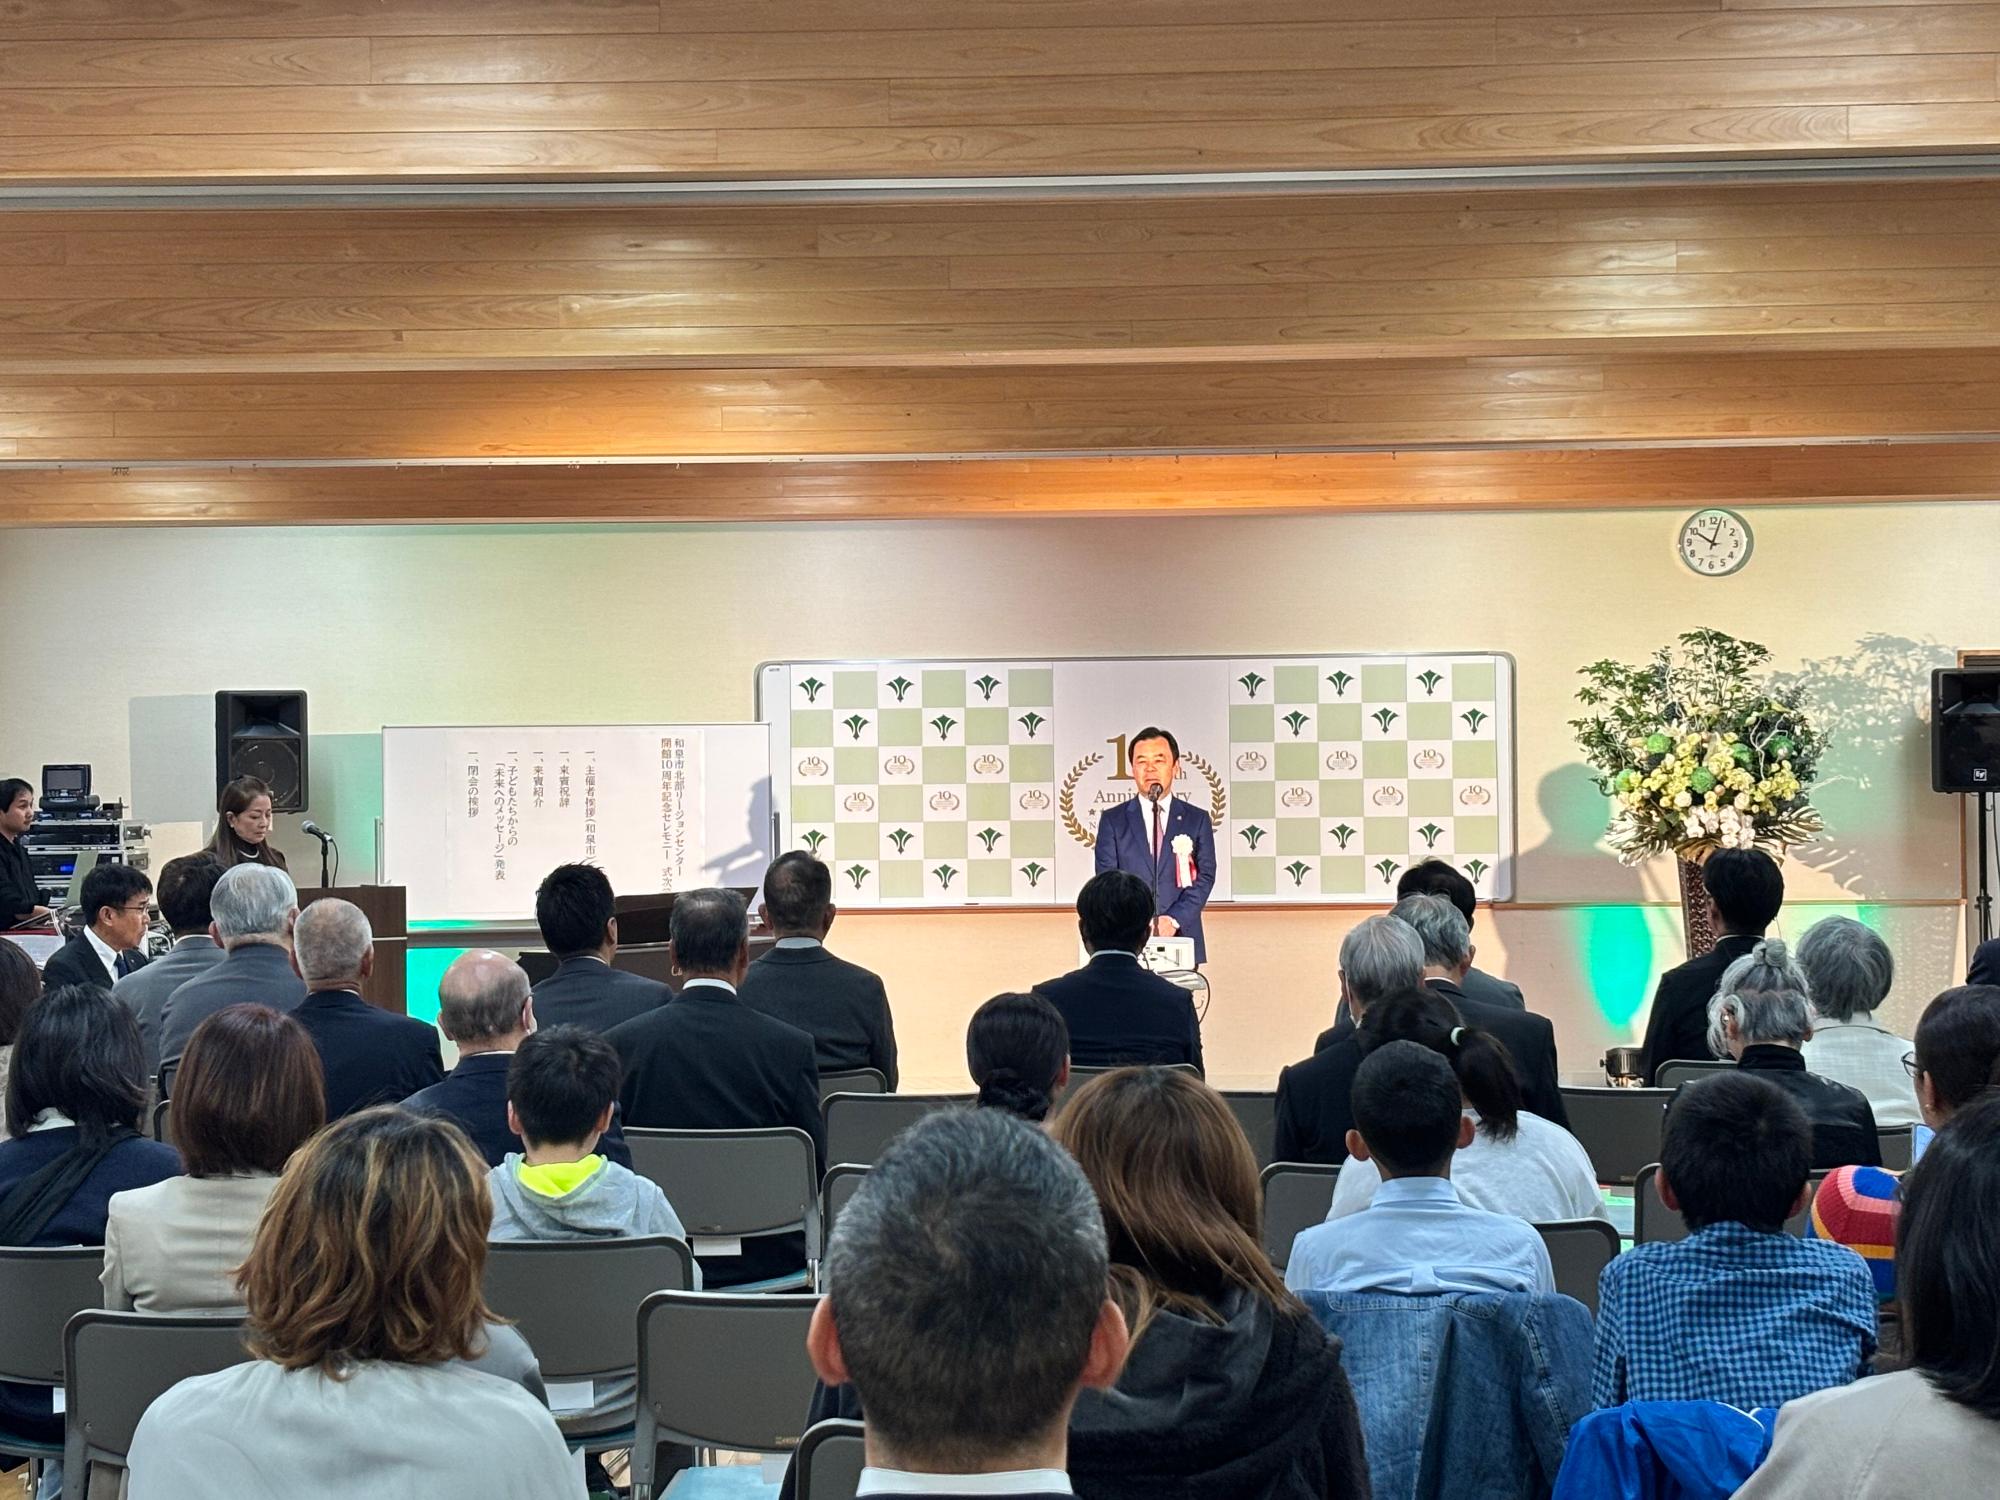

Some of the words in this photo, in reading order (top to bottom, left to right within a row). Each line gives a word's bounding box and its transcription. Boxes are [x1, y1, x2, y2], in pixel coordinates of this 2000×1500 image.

[1699, 519, 1705, 527] 11
[1710, 517, 1718, 525] 12
[1723, 520, 1727, 528] 1
[1729, 528, 1735, 536] 2
[1686, 538, 1692, 546] 9
[1732, 540, 1738, 548] 3
[1690, 550, 1695, 558] 8
[1698, 558, 1704, 566] 7
[1708, 561, 1714, 569] 6
[1720, 559, 1726, 567] 5
[1245, 752, 1258, 760] 10
[1335, 750, 1348, 760] 10
[1422, 749, 1436, 759] 10
[807, 756, 820, 766] 10
[893, 755, 906, 764] 10
[982, 754, 995, 764] 10
[1290, 787, 1304, 796] 10
[1381, 786, 1395, 796] 10
[1468, 785, 1482, 794] 10
[661, 738, 673, 860] 開館10周年記念セレモニー
[852, 792, 866, 801] 10
[938, 790, 951, 800] 10
[1028, 790, 1041, 799] 10
[674, 738, 685, 877] 和泉市北部リージョンセンター
